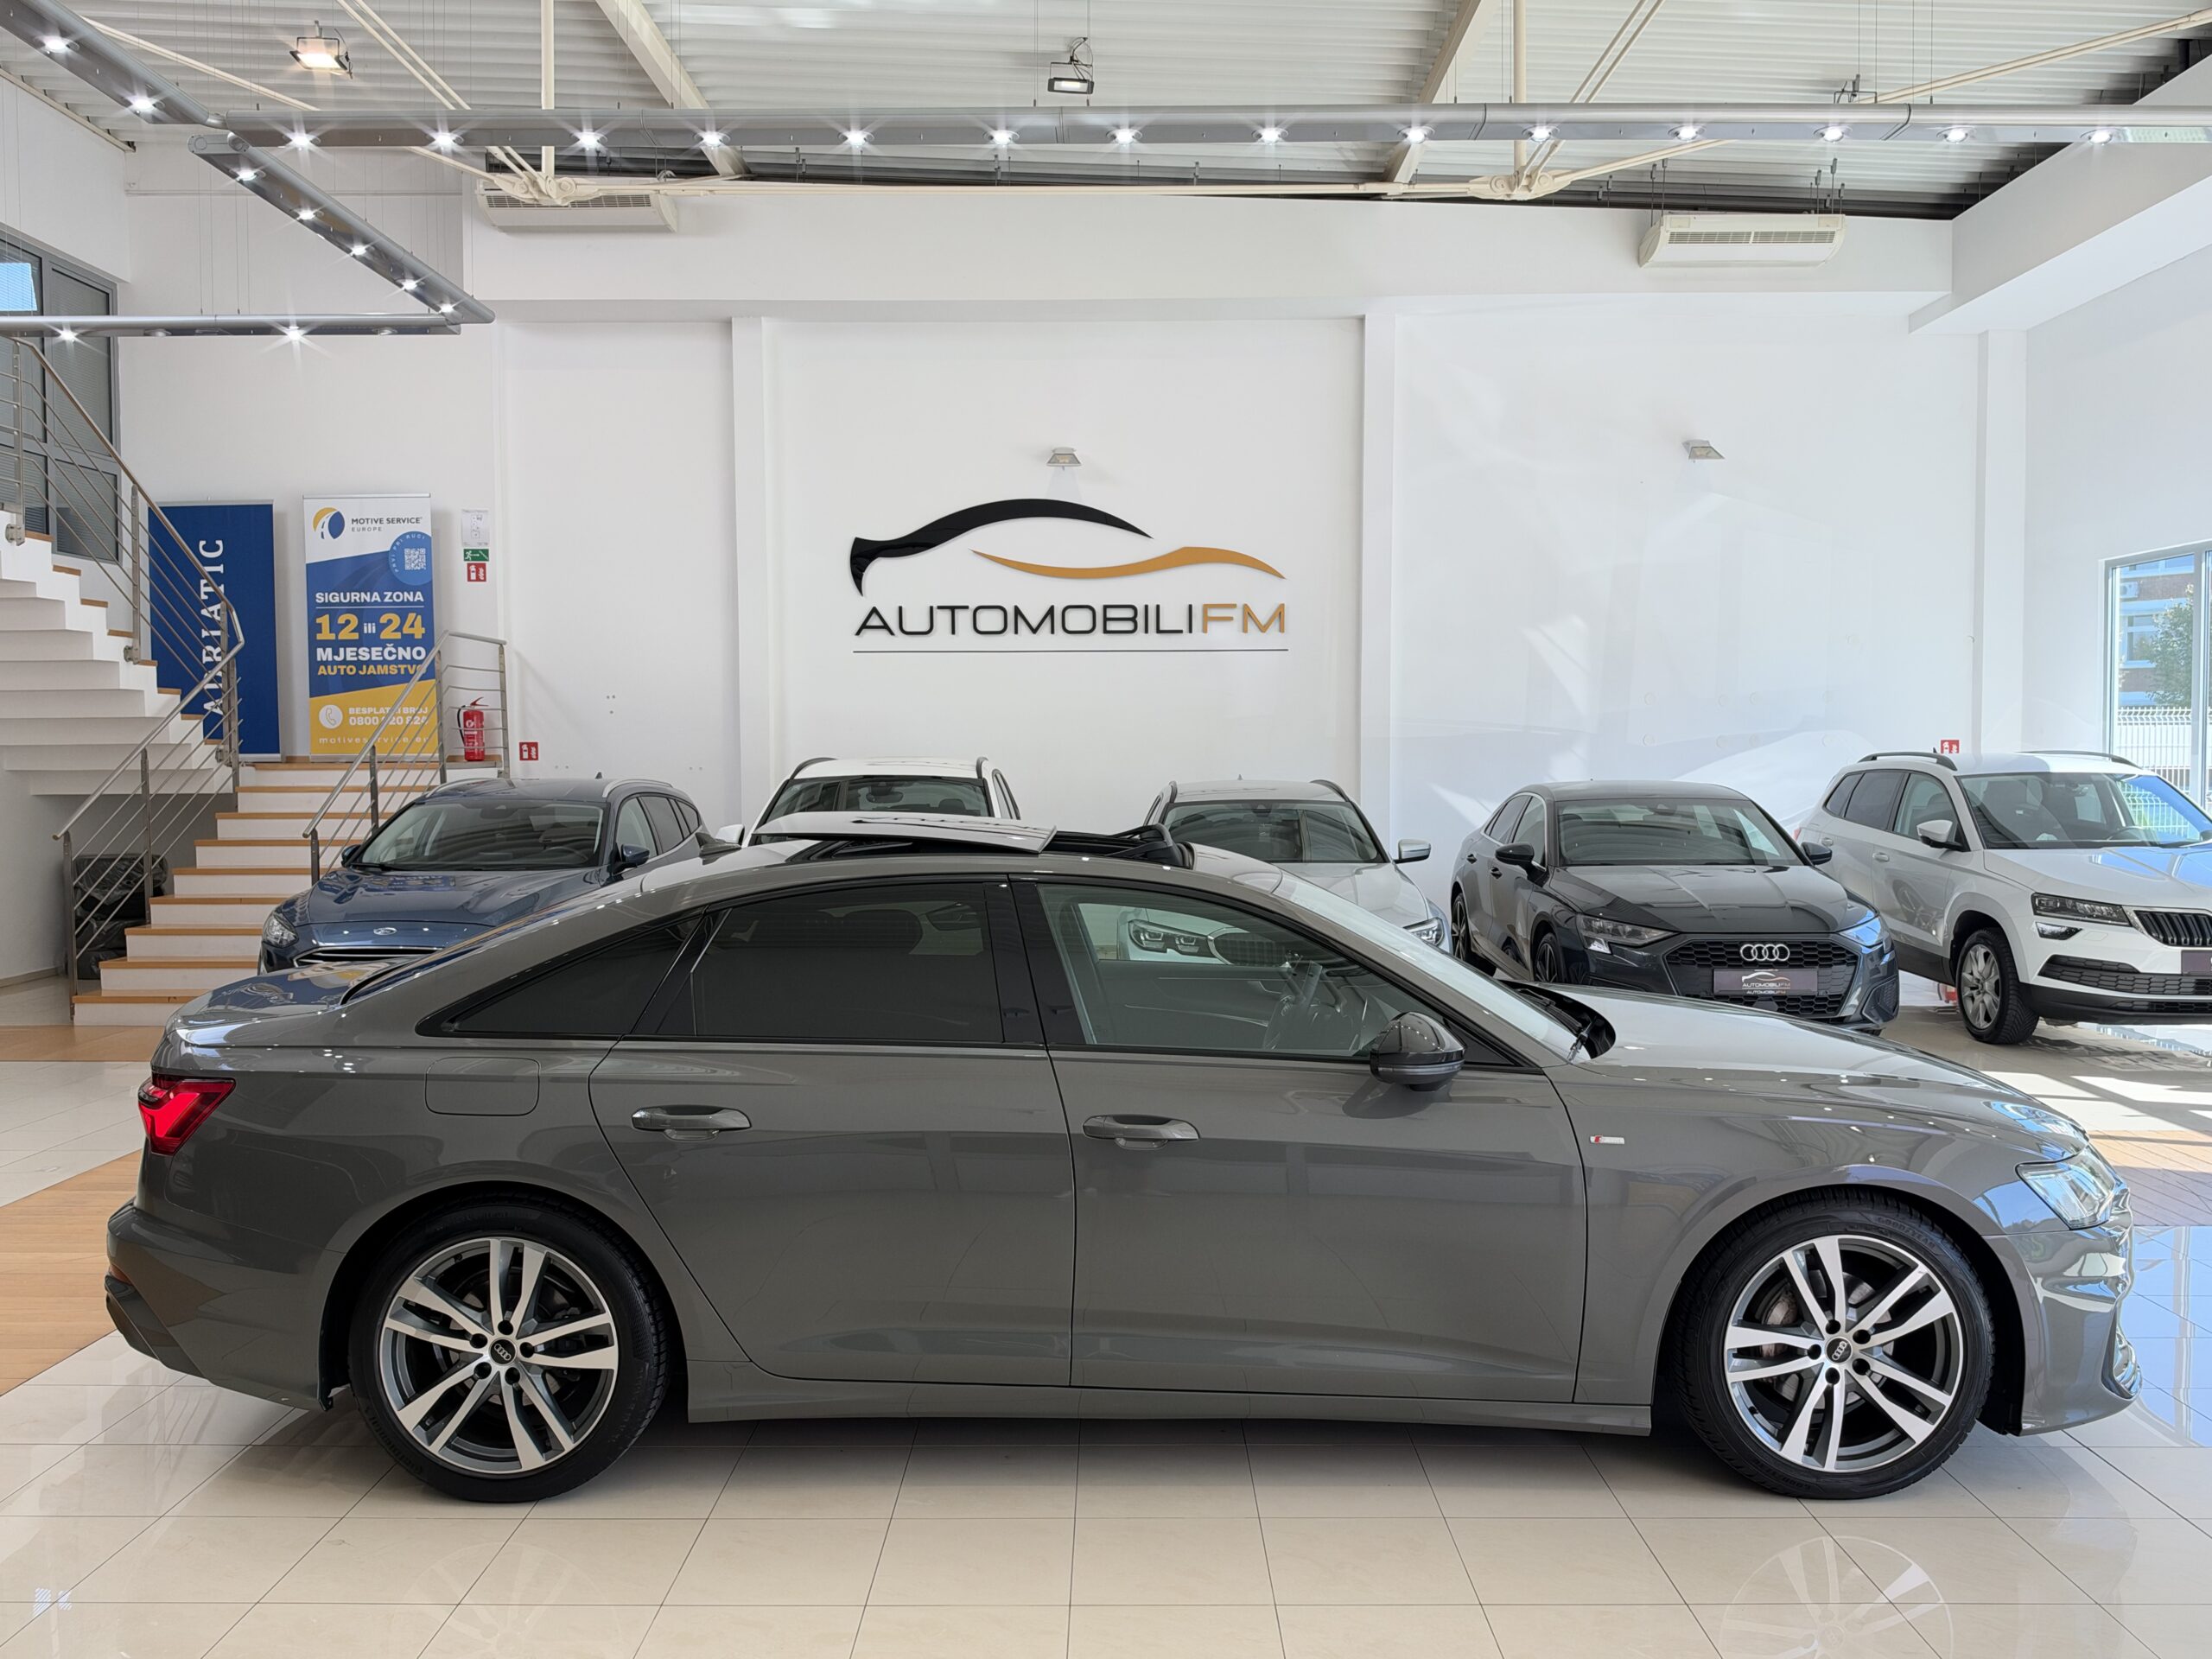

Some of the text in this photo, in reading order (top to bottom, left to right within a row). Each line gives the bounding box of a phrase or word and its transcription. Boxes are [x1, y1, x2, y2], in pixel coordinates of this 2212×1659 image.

[315, 591, 424, 603] SIGURNA ZONA
[855, 602, 1286, 636] AUTOMOBILIFM
[315, 612, 426, 640] 12 ili 24
[316, 643, 427, 662] MJESEČNO
[317, 664, 357, 676] AUTO
[348, 706, 401, 715] BESPLATI
[348, 716, 379, 726] 0800
